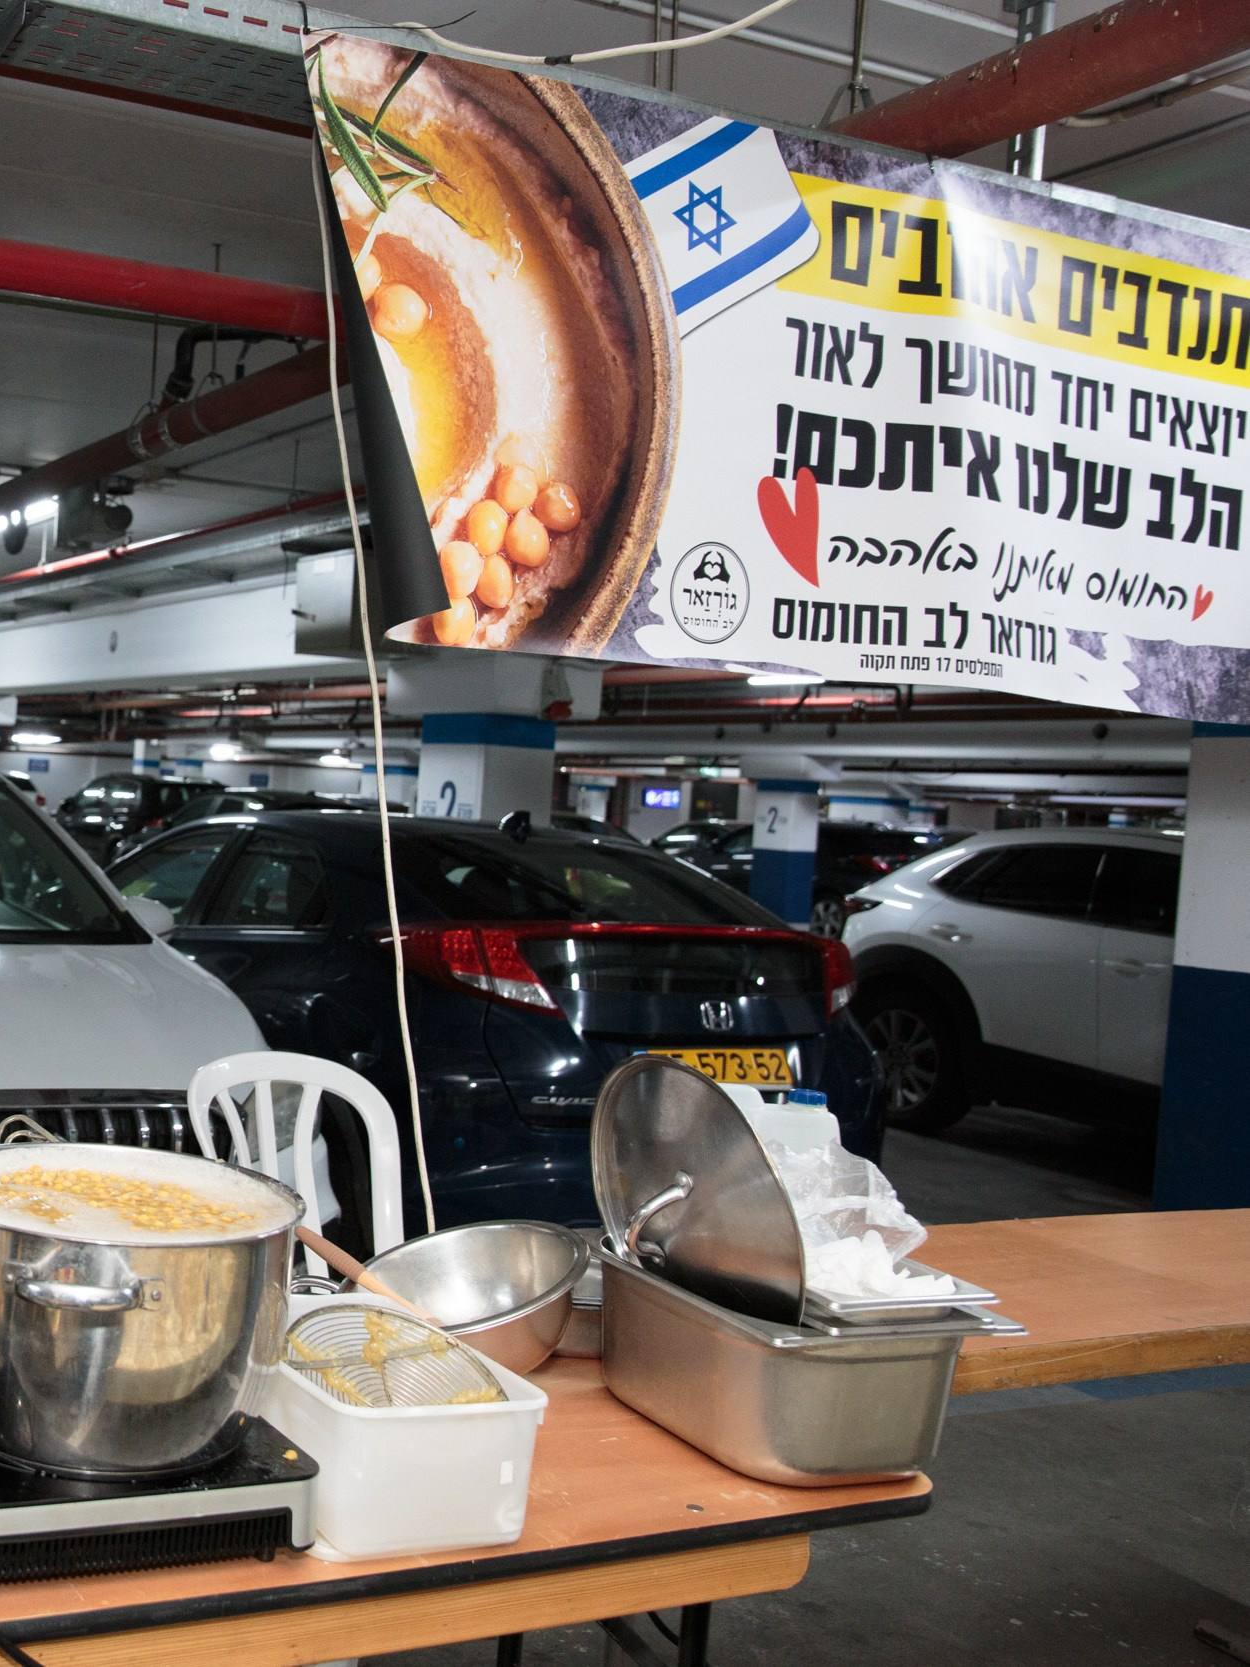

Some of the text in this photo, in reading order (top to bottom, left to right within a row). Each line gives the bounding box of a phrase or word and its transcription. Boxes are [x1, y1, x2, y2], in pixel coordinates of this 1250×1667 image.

[786, 316, 1248, 458] יוצאים יחד מחושך לאור
[773, 403, 1244, 551] הלב שלנו איתכם!
[828, 526, 1188, 611] החומוס מאיתנו באהבה
[683, 616, 735, 629] לב החומוס
[772, 597, 1056, 666] גורזאר לב החומוס
[860, 654, 1004, 679] המפלסים 17 פתח תקוה
[766, 806, 779, 835] 2
